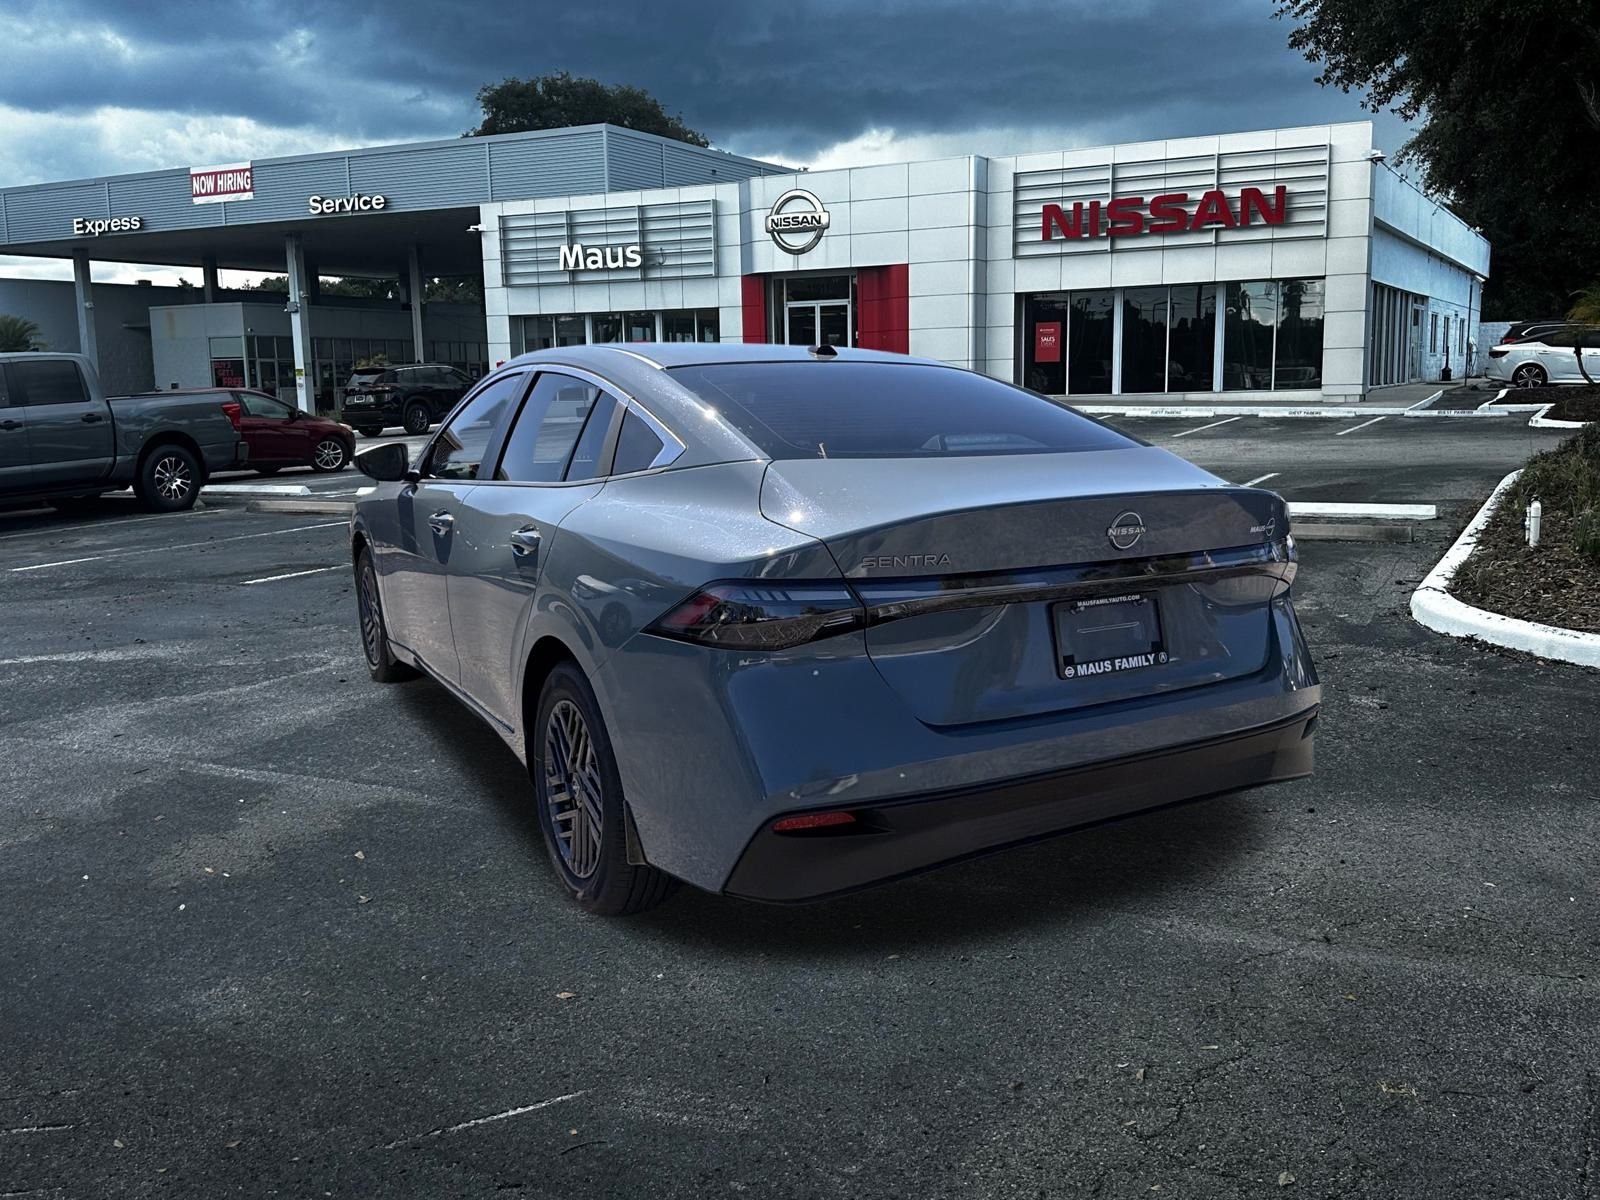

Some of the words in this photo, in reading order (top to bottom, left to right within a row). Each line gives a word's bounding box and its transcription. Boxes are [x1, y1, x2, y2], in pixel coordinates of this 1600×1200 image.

[193, 174, 215, 194] NOW
[217, 171, 251, 192] HIRING
[309, 193, 385, 214] Service
[1042, 185, 1287, 241] NISSAN
[73, 216, 141, 236] Express
[770, 215, 821, 228] NISSAN
[560, 243, 642, 270] Maus
[223, 377, 243, 386] FREE
[1108, 526, 1146, 536] NISSAN
[862, 553, 952, 569] SENTRA
[1077, 594, 1140, 607] MAUSFAMILYAUTO.COM
[1077, 660, 1112, 676] MAUS
[1115, 653, 1155, 670] FAMILY
